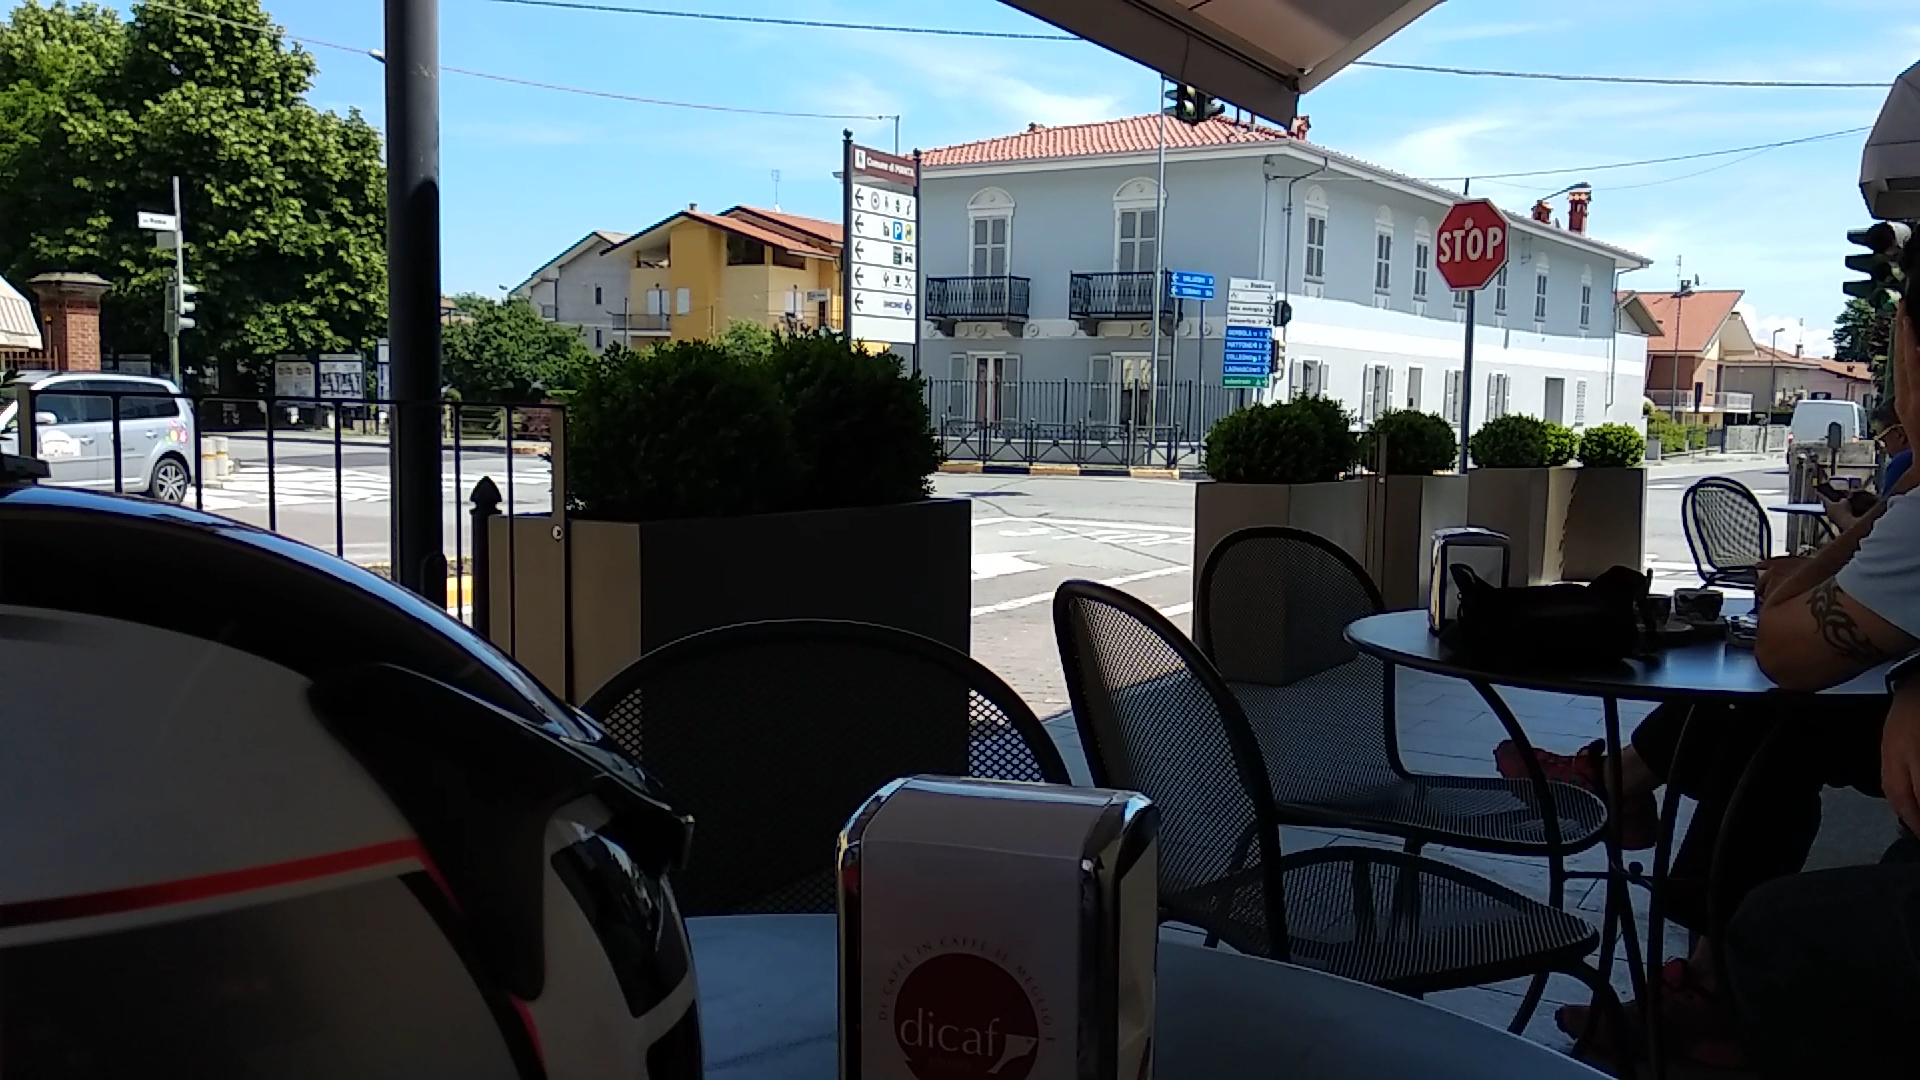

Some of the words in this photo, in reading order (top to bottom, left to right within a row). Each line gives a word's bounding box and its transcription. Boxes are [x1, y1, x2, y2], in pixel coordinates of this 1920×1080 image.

[866, 156, 889, 170] Comune
[889, 162, 895, 173] di
[1438, 226, 1503, 263] STOP
[900, 1007, 1001, 1057] dicaf
